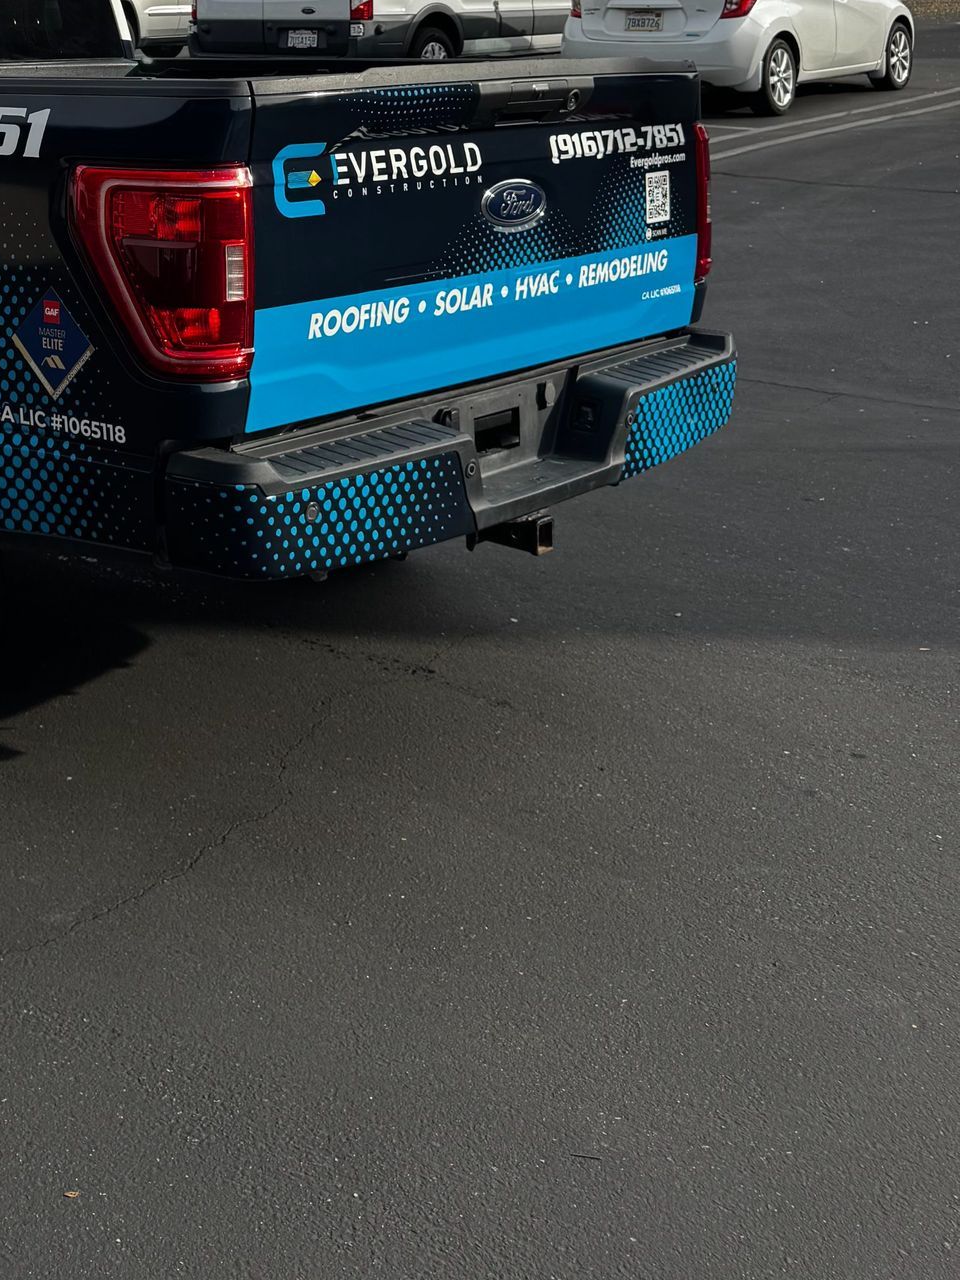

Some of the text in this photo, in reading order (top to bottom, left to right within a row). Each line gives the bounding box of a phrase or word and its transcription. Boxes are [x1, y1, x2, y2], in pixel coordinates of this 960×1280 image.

[549, 122, 685, 164] (916)712-7851
[329, 142, 482, 186] EVERGOLD
[630, 152, 686, 169] Evergoldpros.com
[333, 175, 483, 199] CONSTRUCTION
[500, 189, 535, 217] Ford
[308, 249, 669, 340] ROOFING SOLAR HVAC REMODELING
[44, 307, 60, 317] GAF
[38, 327, 66, 339] MASTER
[42, 337, 64, 351] ELITE
[19, 407, 47, 429] LIC
[51, 413, 127, 445] #1065118
